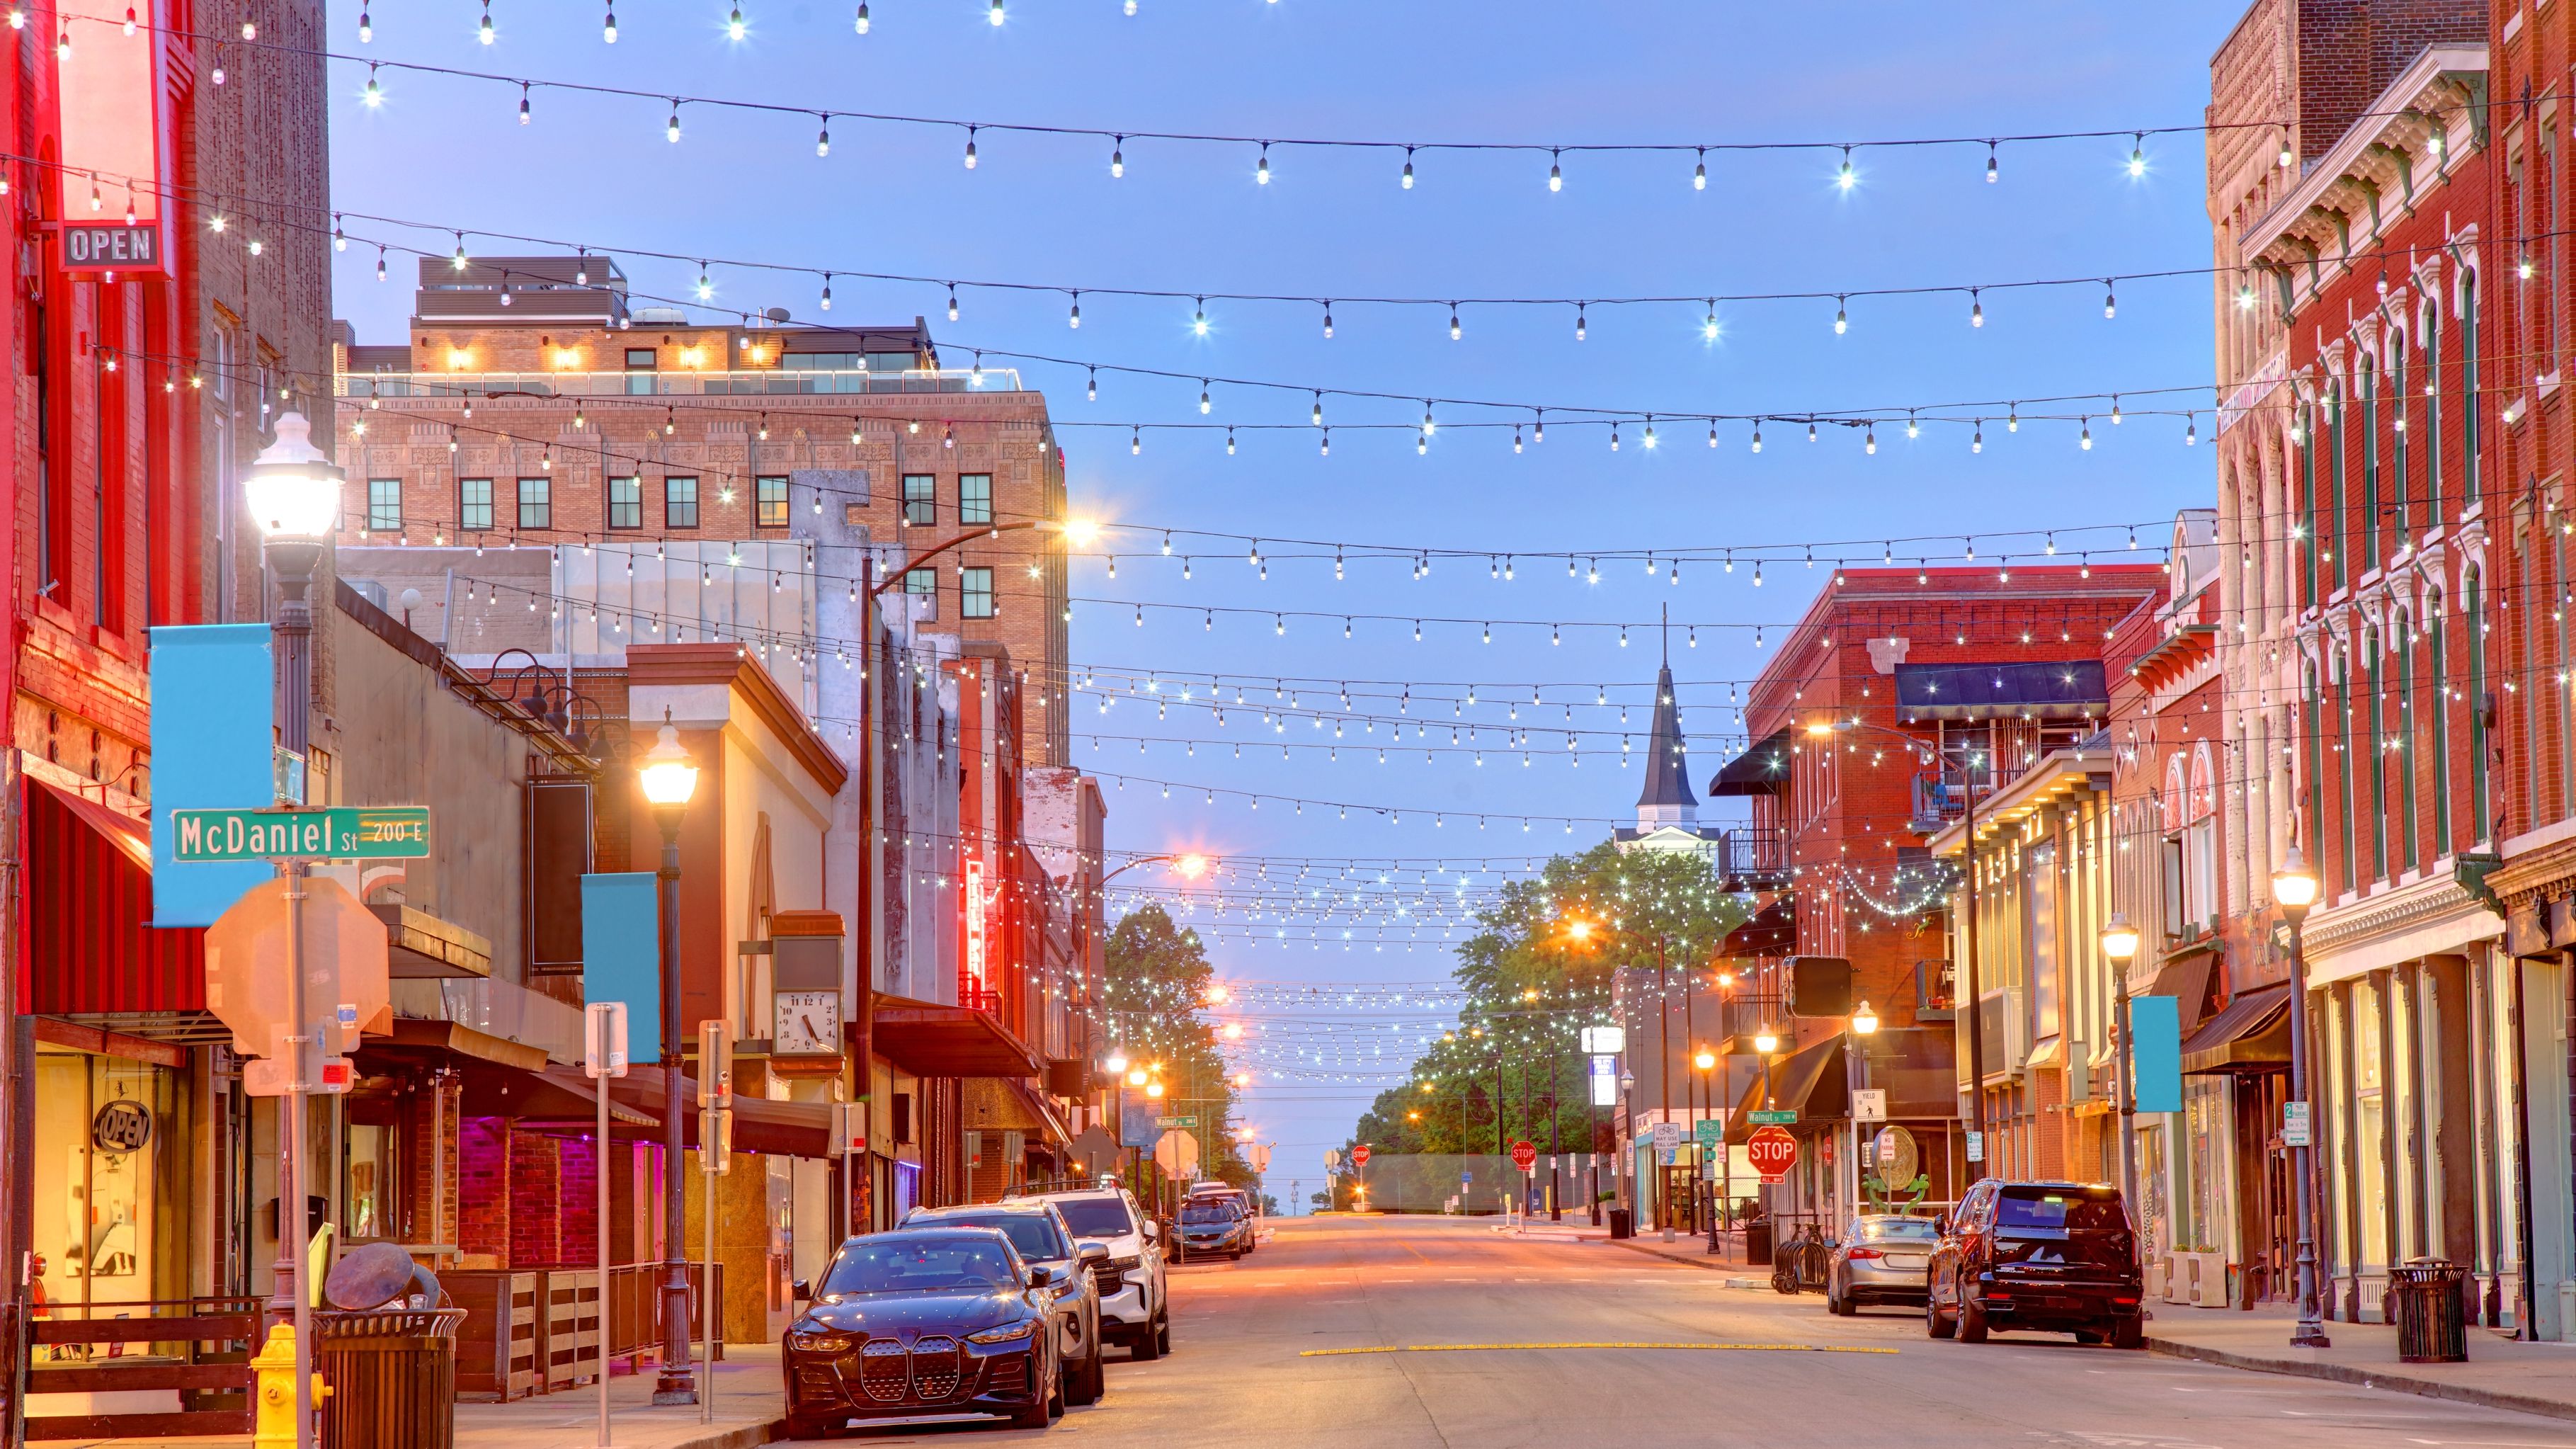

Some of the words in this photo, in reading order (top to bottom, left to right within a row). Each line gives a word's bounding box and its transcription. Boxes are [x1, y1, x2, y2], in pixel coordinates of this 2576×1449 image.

[70, 229, 150, 261] OPEN
[181, 815, 332, 854] McDaniel
[341, 832, 358, 852] St
[373, 823, 405, 843] 200
[414, 822, 423, 842] E
[1748, 1113, 1772, 1122] Walnut
[2286, 1106, 2291, 1116] 2
[103, 1108, 148, 1147] OPEN
[1513, 1149, 1534, 1158] STOP
[1751, 1142, 1794, 1160] STOP
